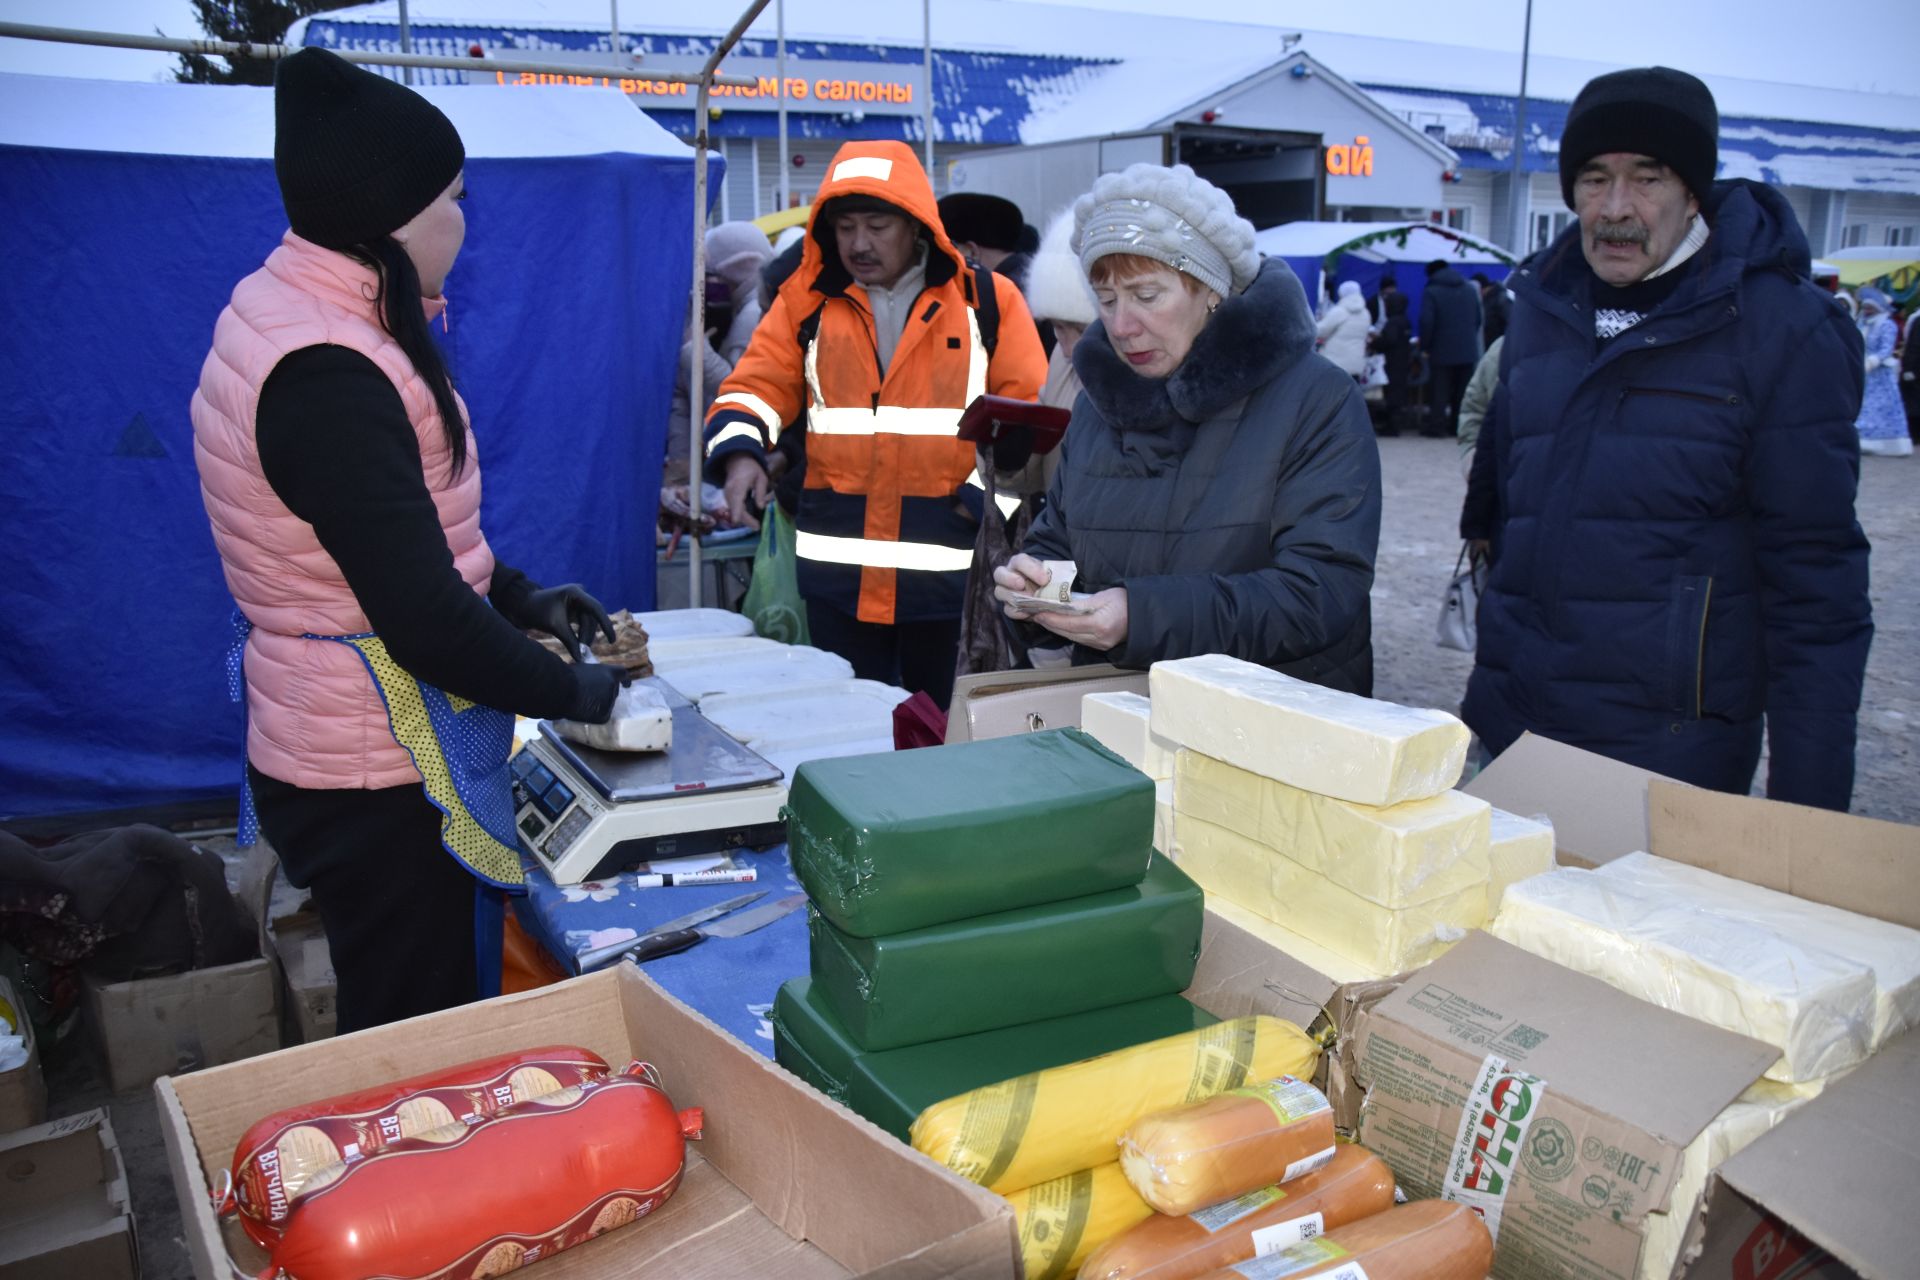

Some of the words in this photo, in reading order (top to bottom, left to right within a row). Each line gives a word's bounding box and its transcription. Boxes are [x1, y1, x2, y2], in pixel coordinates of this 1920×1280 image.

[814, 78, 913, 103] салоны
[493, 1084, 515, 1107] ВЕ
[1474, 1101, 1482, 1109] 8
[379, 1114, 402, 1144] ВЕТ
[1463, 1109, 1479, 1147] (84366)
[1453, 1148, 1468, 1184] 3-52-49
[257, 1148, 289, 1222] ВЕТЧИНА
